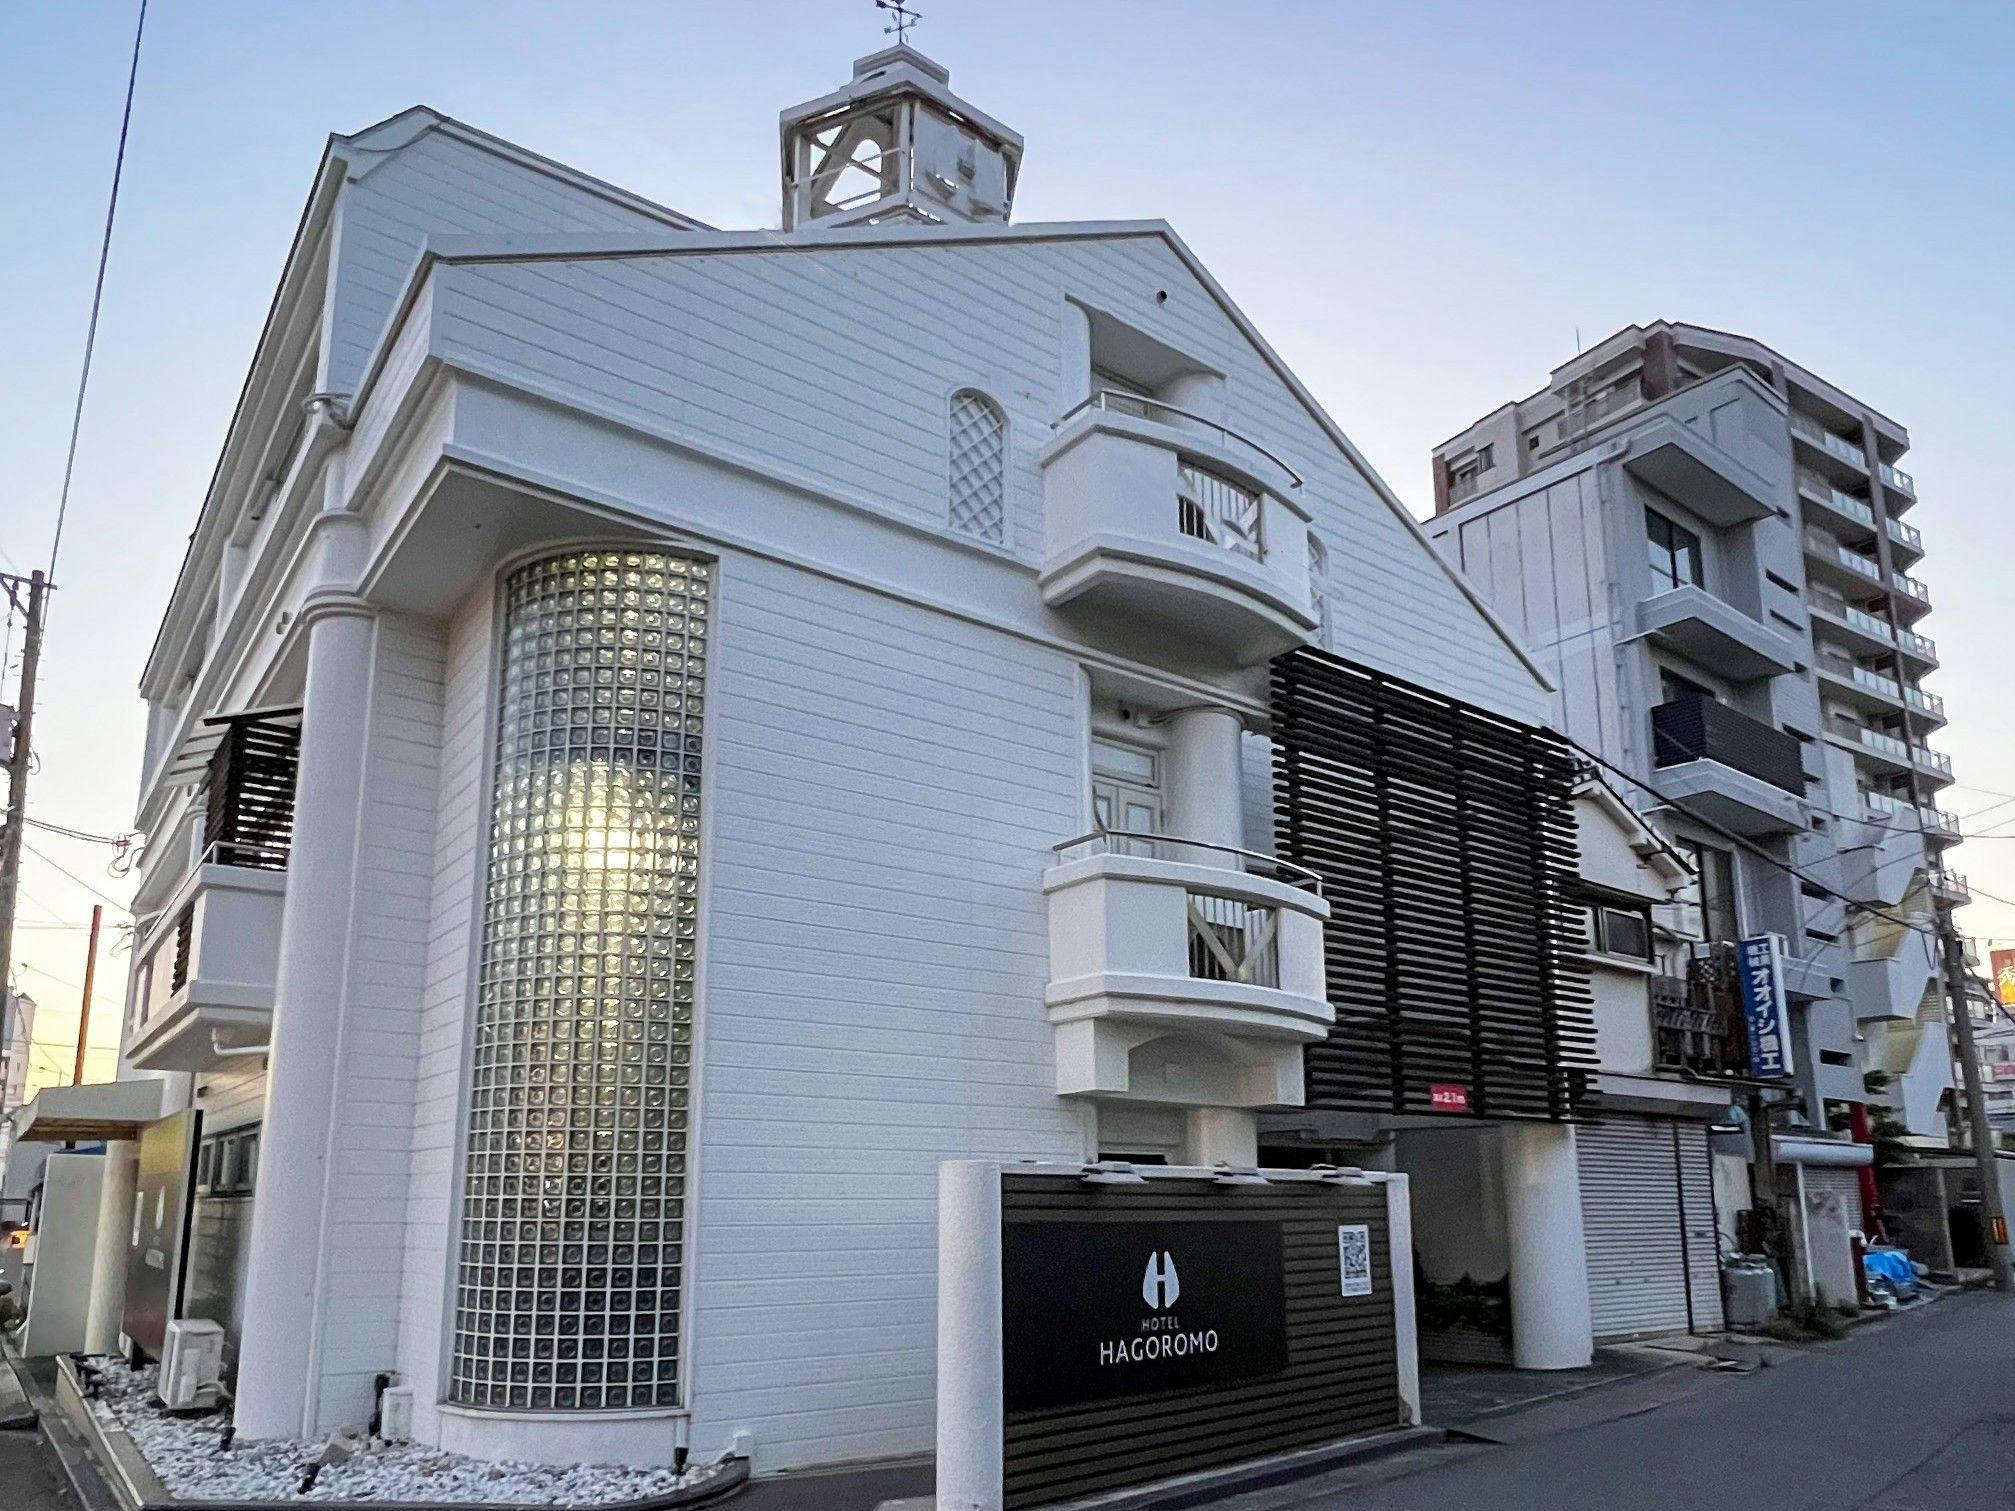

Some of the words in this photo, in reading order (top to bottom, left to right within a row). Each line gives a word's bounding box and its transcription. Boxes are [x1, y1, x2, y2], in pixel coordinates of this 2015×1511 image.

[1751, 968, 1782, 1070] オオイシ工
[1141, 1316, 1180, 1331] HOTEL
[1100, 1329, 1218, 1366] HAGOROMO
